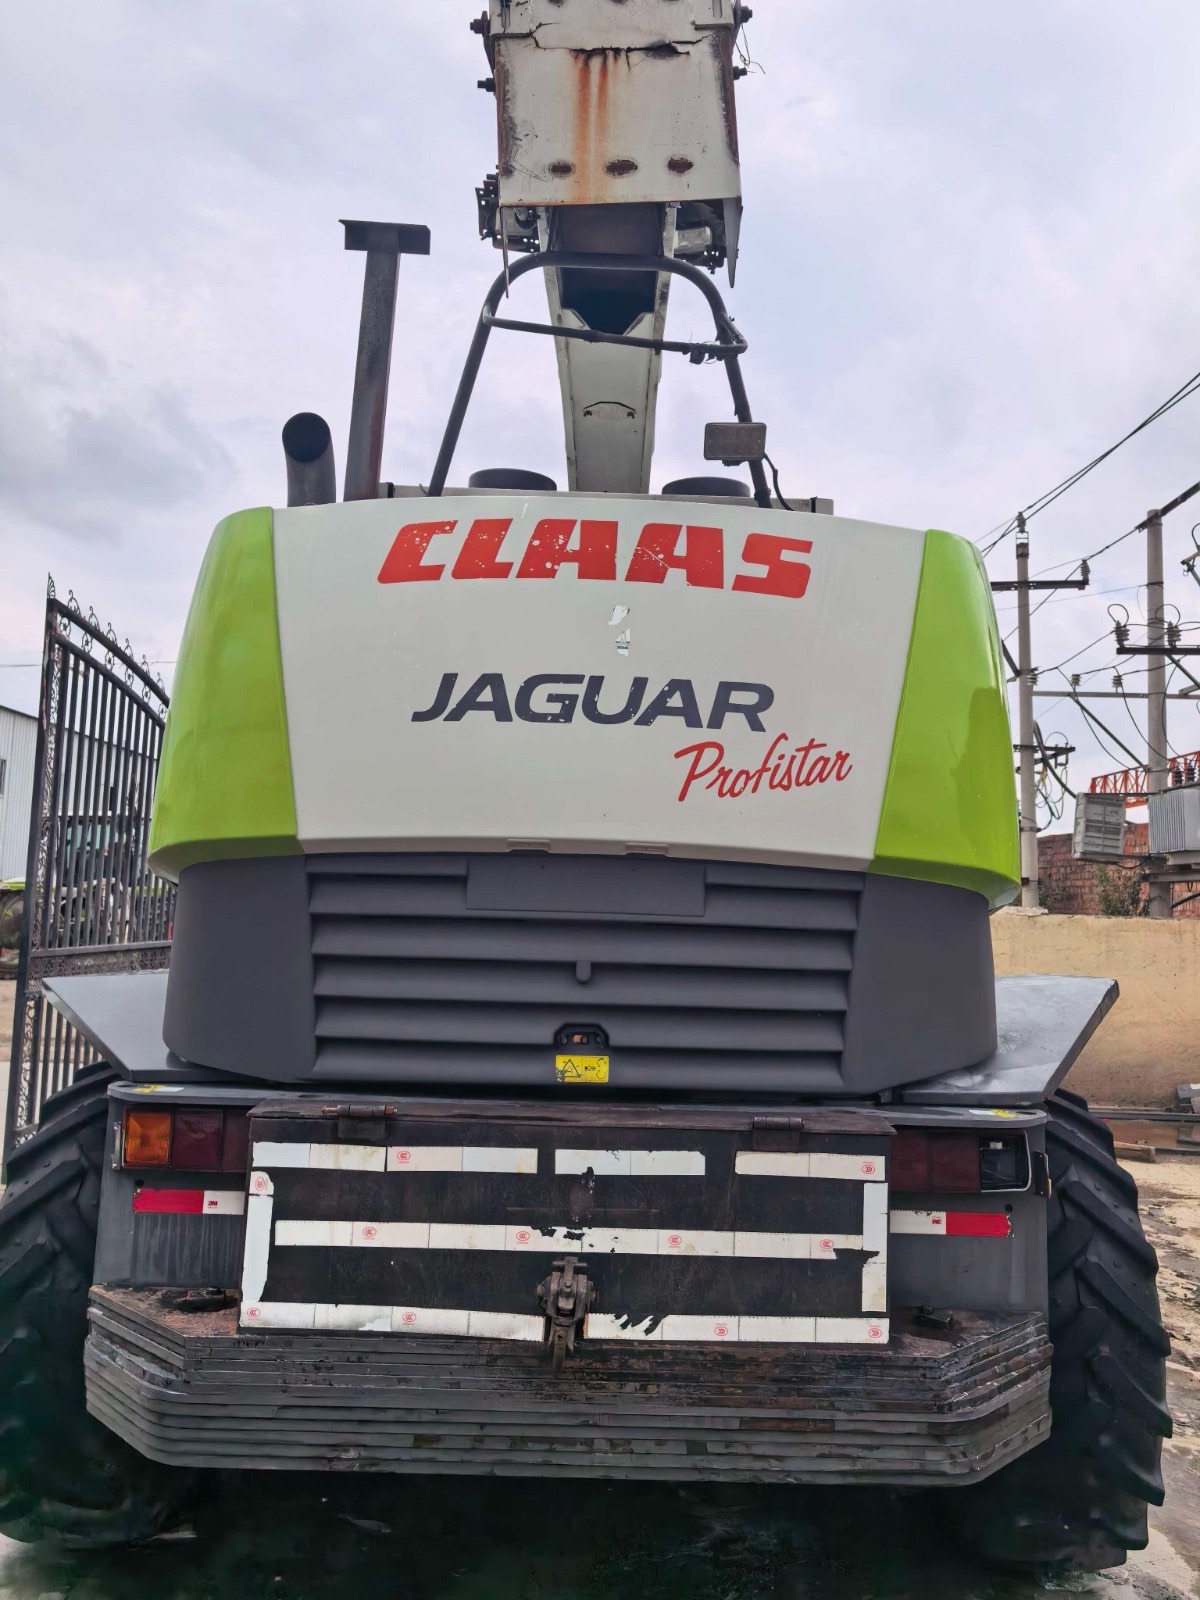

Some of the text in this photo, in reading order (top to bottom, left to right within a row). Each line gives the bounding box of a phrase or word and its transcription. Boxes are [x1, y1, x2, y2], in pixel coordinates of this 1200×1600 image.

[377, 518, 812, 598] CLAAS
[411, 673, 774, 732] JAGUAR
[674, 733, 850, 801] Profistar
